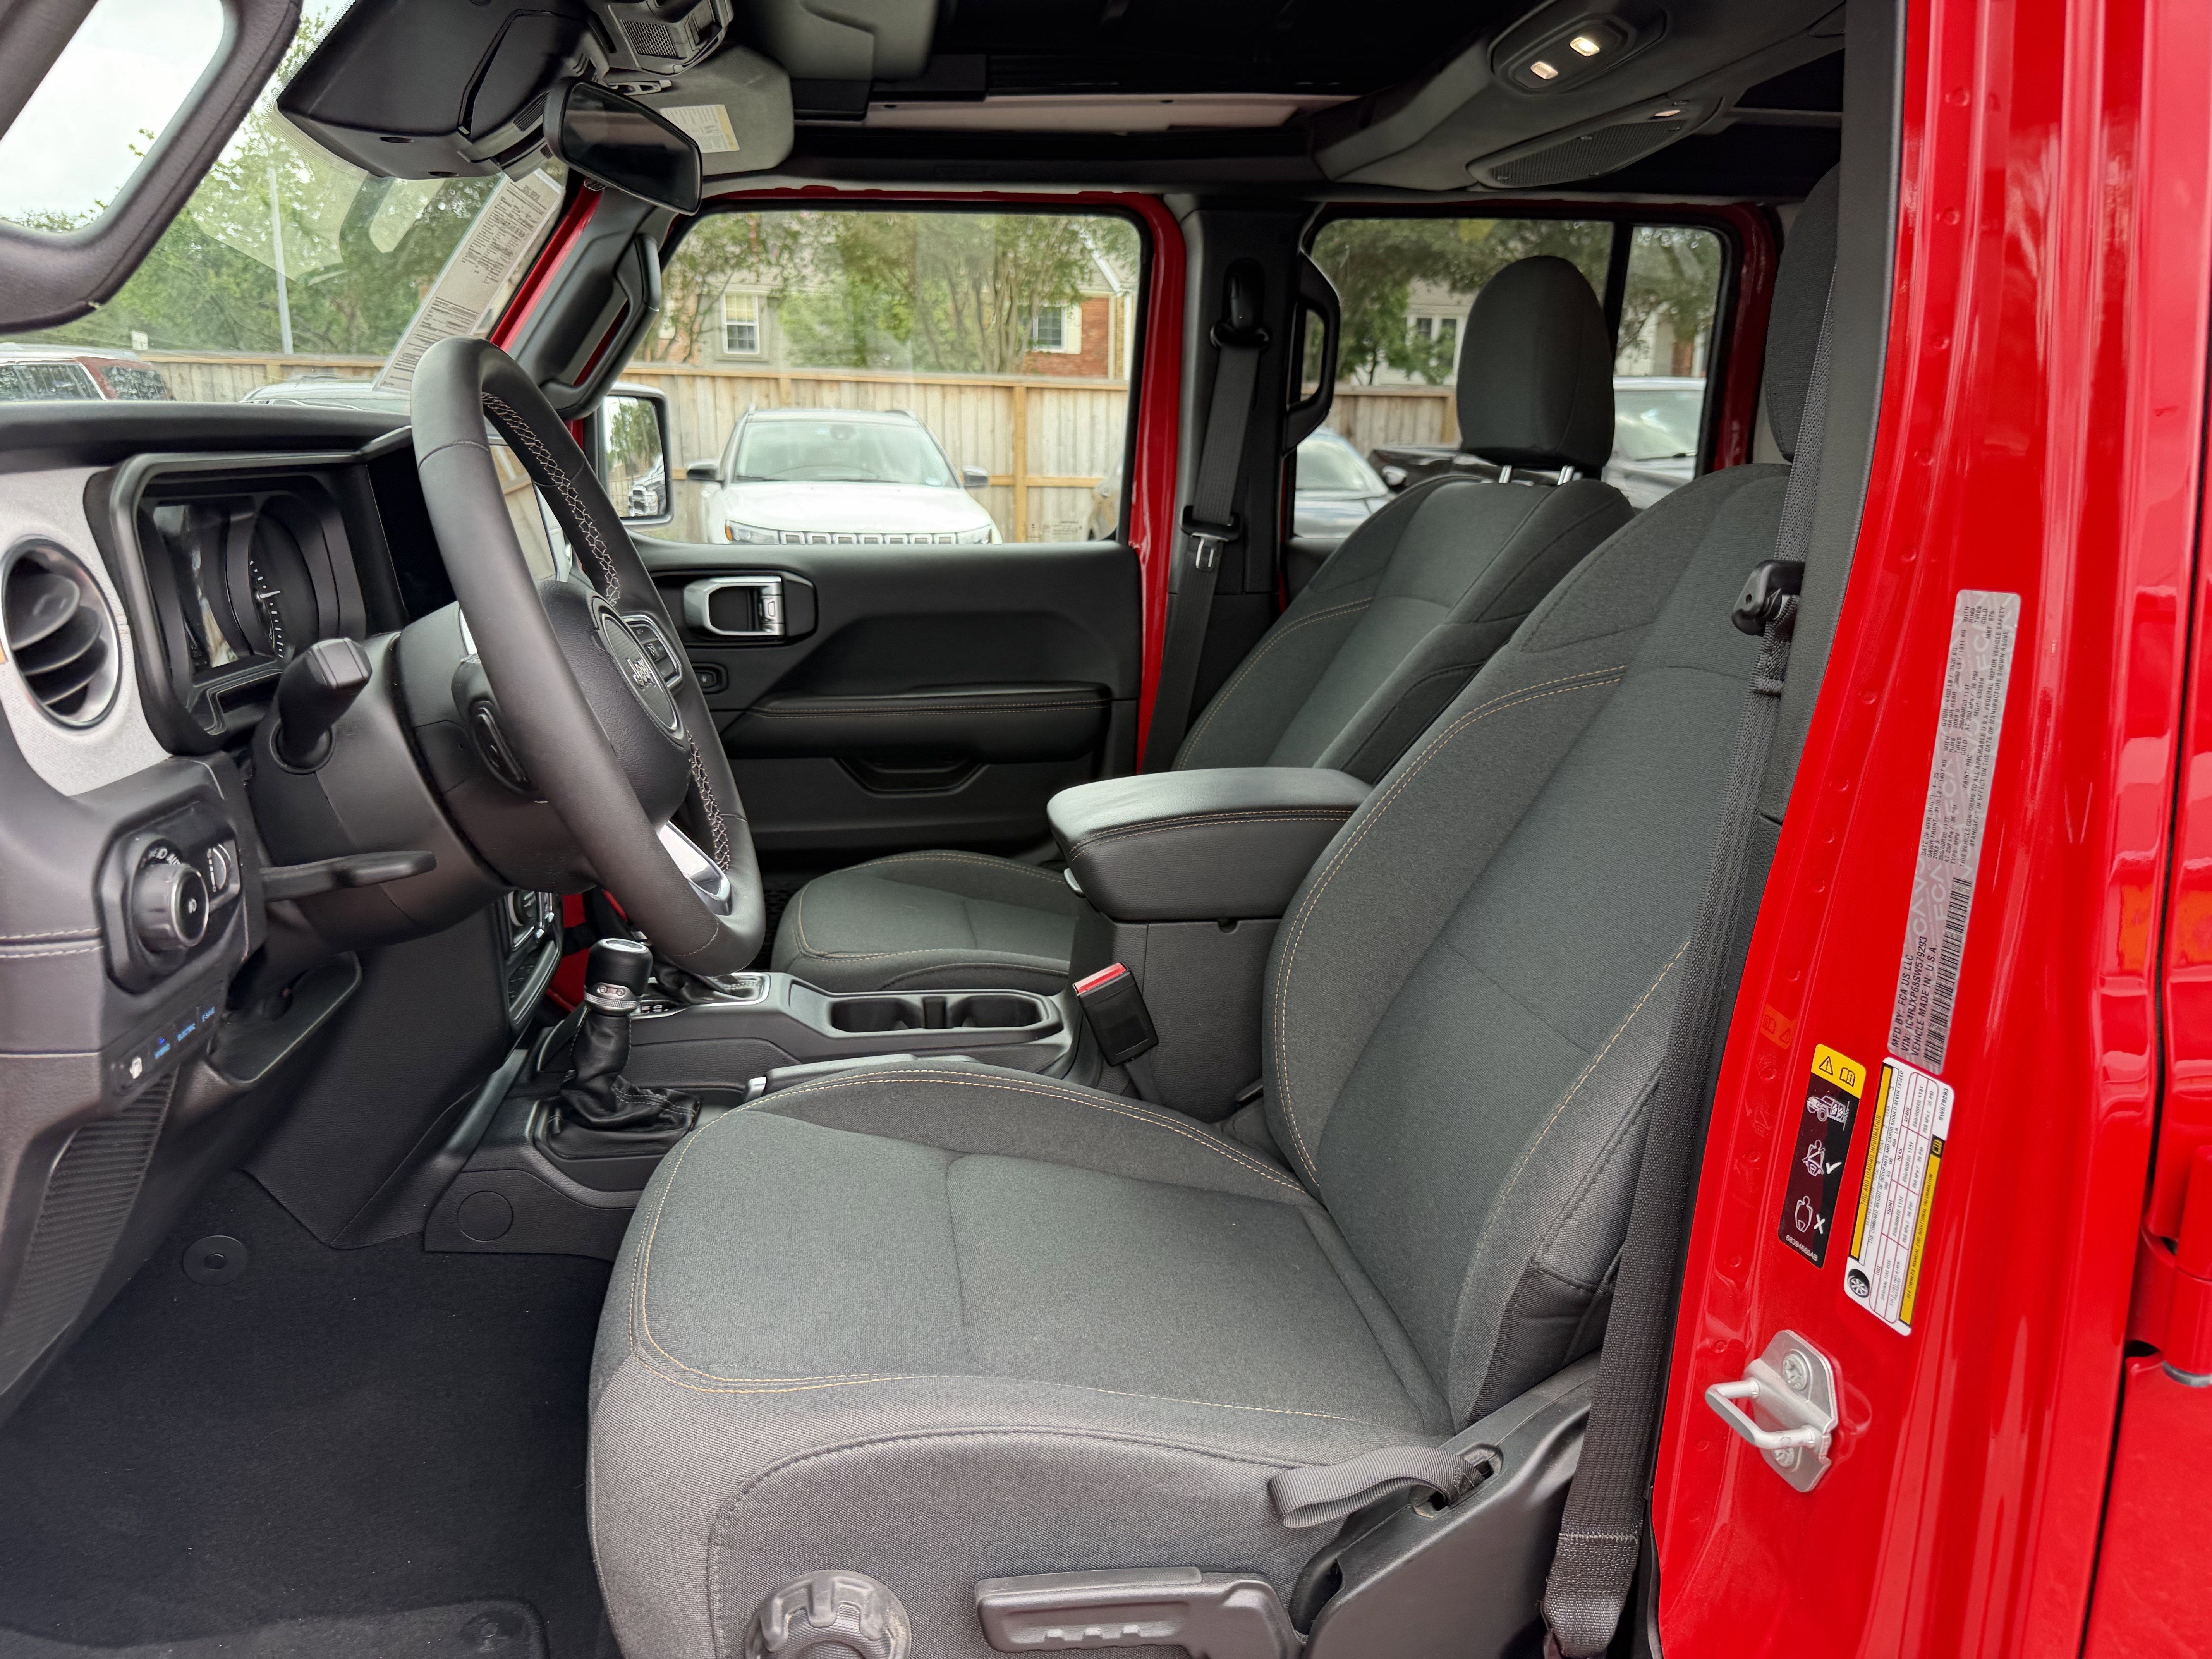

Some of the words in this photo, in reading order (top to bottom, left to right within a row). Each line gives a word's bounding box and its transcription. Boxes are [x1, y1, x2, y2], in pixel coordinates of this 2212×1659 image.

[1996, 606, 2005, 630] SAFETY
[1992, 632, 2002, 657] VEHICLE
[1988, 659, 1997, 680] MOTOR
[1996, 653, 2005, 676] SHOWN
[1984, 684, 1993, 710] FEDERAL
[1989, 679, 2001, 725] MANUFACTURE
[1964, 723, 1970, 731] AT
[1988, 726, 1993, 734] OF
[1975, 733, 1985, 769] APPLICABLE
[1984, 736, 1992, 752] DATE
[1981, 768, 1987, 776] ON
[1977, 779, 1985, 801] EFFECT
[1966, 793, 1976, 826] CONORMS
[1961, 828, 1970, 852] VEHICLE
[1903, 954, 1913, 971] LLC
[1925, 941, 1937, 972] U.S.A.
[1901, 972, 1910, 986] US
[1898, 989, 1908, 1006] FCA
[1917, 989, 1929, 1017] MADE
[1894, 1010, 1905, 1025] BY:
[1891, 1027, 1901, 1048] MFD
[1901, 1033, 1911, 1051] VIN:
[1911, 1018, 1924, 1056] VEHICLE
[1864, 1153, 1874, 1179] LOADING
[1869, 1113, 1881, 1154] INFORMATION
[1870, 1209, 1878, 1234] COMBINED
[1879, 1154, 1888, 1182] OCCUPANTS
[1917, 1208, 1926, 1236] ADDITIONAL
[1923, 1173, 1933, 1207] INFORMATION
